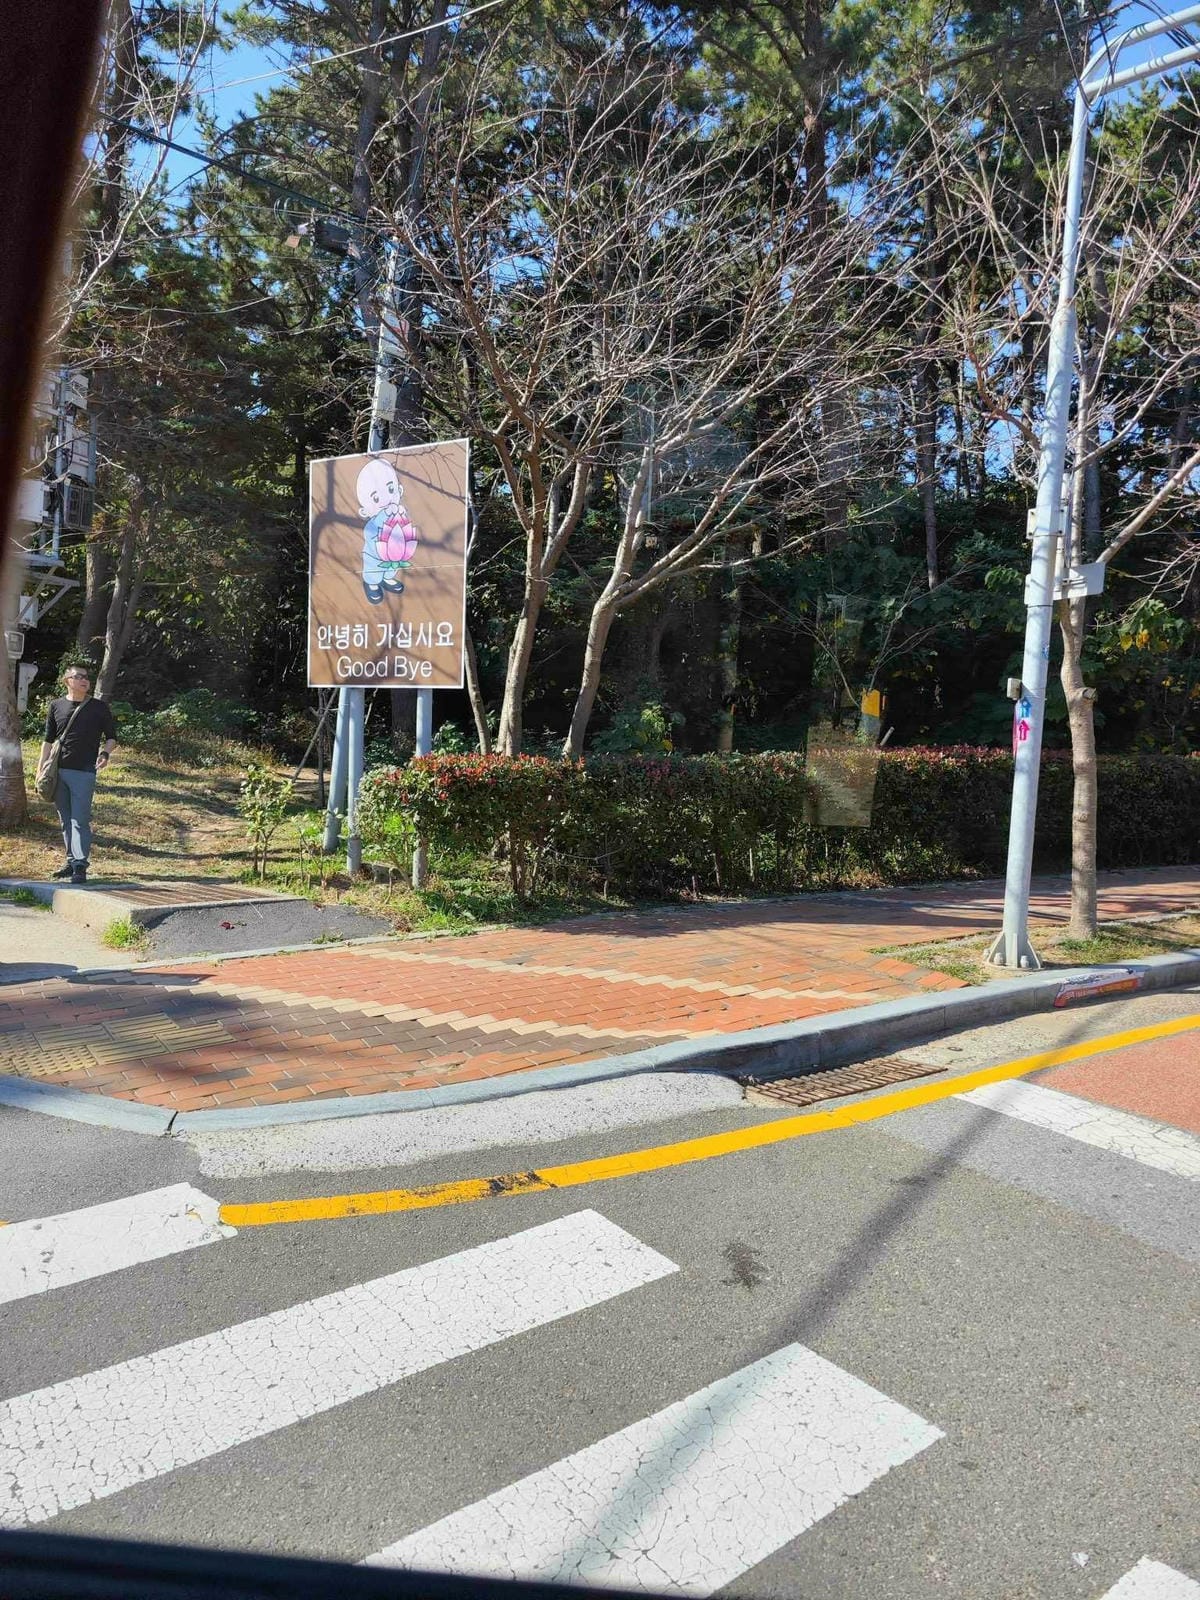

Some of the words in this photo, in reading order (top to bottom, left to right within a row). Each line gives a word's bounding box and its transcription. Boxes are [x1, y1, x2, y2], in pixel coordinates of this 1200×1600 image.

[317, 623, 369, 650] 안녕히
[376, 621, 454, 649] 가십시요
[336, 655, 388, 678] Good
[394, 655, 433, 681] Bye
